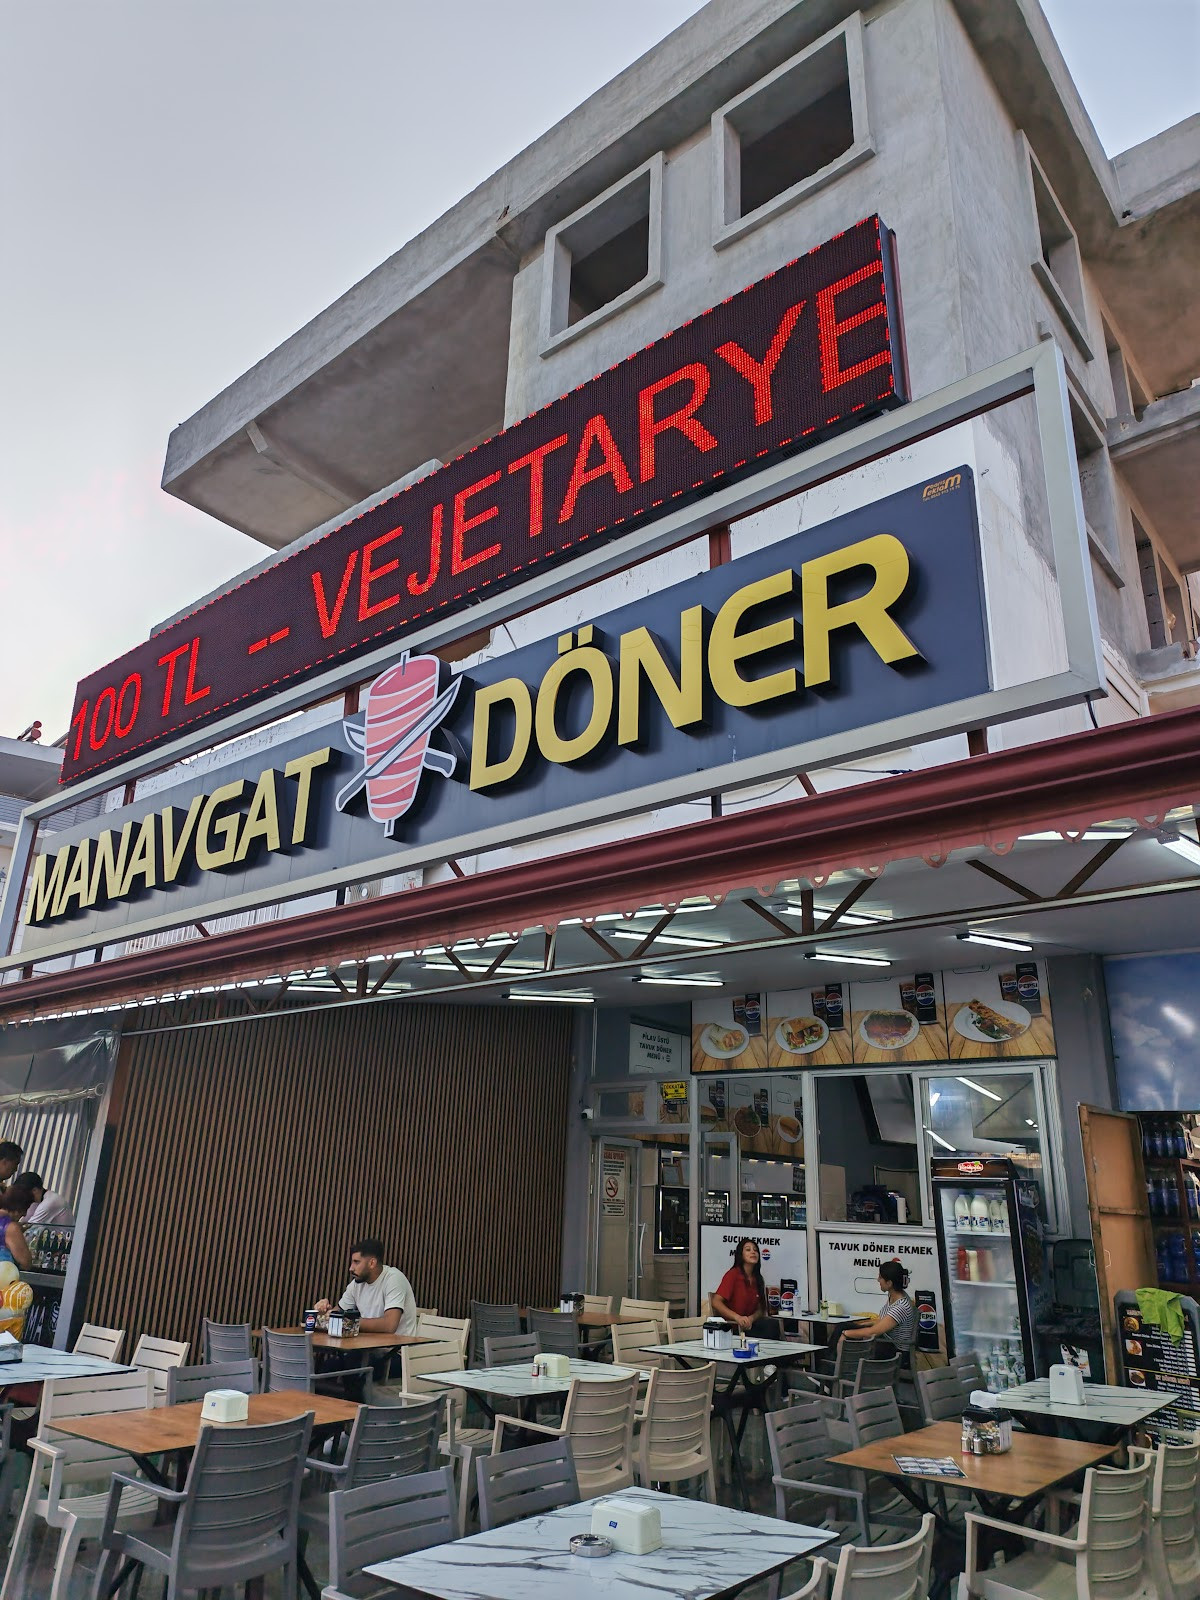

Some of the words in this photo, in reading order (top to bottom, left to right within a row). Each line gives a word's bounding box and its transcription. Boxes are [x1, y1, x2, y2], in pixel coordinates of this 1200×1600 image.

[71, 673, 142, 761] 100
[157, 637, 211, 717] TL
[311, 259, 893, 639] VEJETARYE
[25, 747, 331, 925] MANAVGAT
[470, 533, 919, 791] DÖNER
[639, 1042, 656, 1051] TAVUK
[828, 1242, 860, 1252] TAVUK
[862, 1242, 895, 1253] DÖNER
[898, 1245, 933, 1255] EKMEK
[853, 1257, 880, 1267] MENÜ
